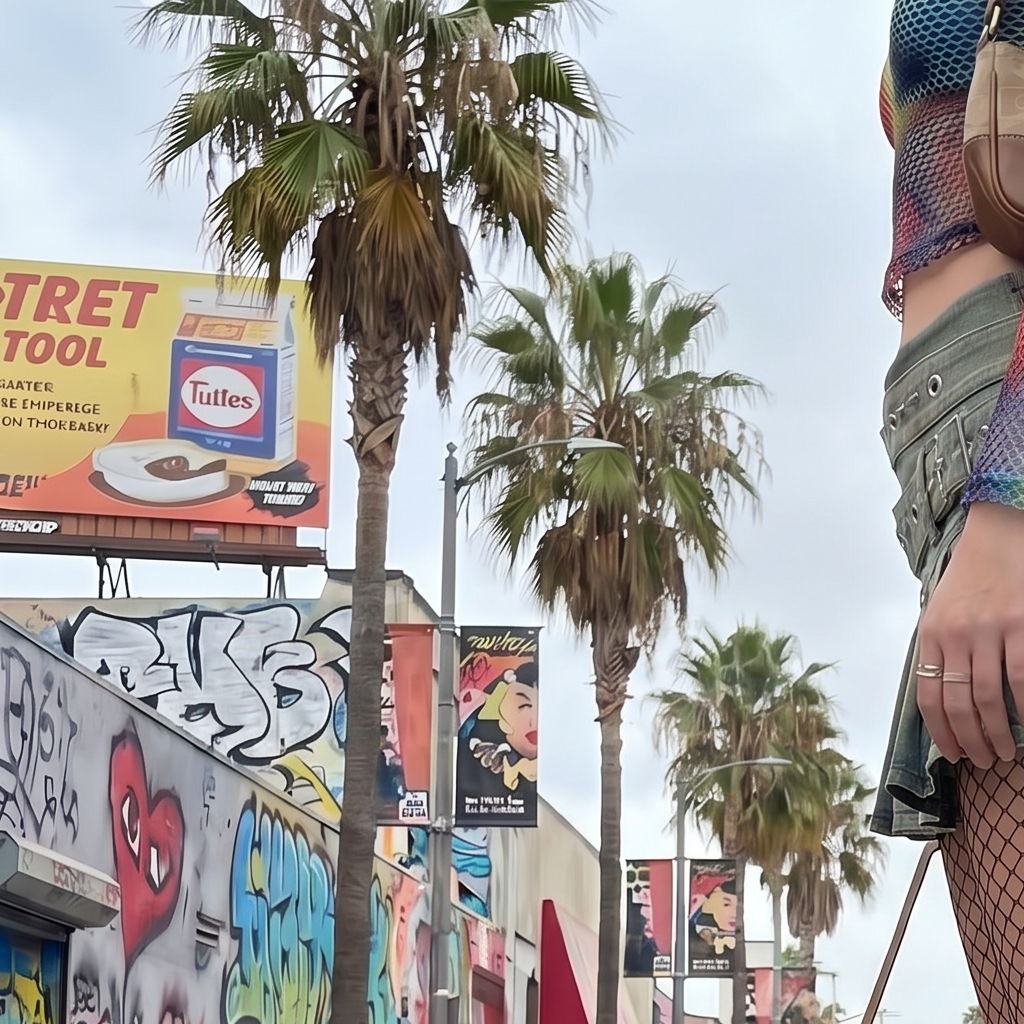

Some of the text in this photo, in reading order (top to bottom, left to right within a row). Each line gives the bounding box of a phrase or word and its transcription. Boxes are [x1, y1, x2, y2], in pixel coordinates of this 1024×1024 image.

[0, 272, 159, 329] TRET
[3, 329, 107, 368] TOOL
[2, 416, 23, 427] ON
